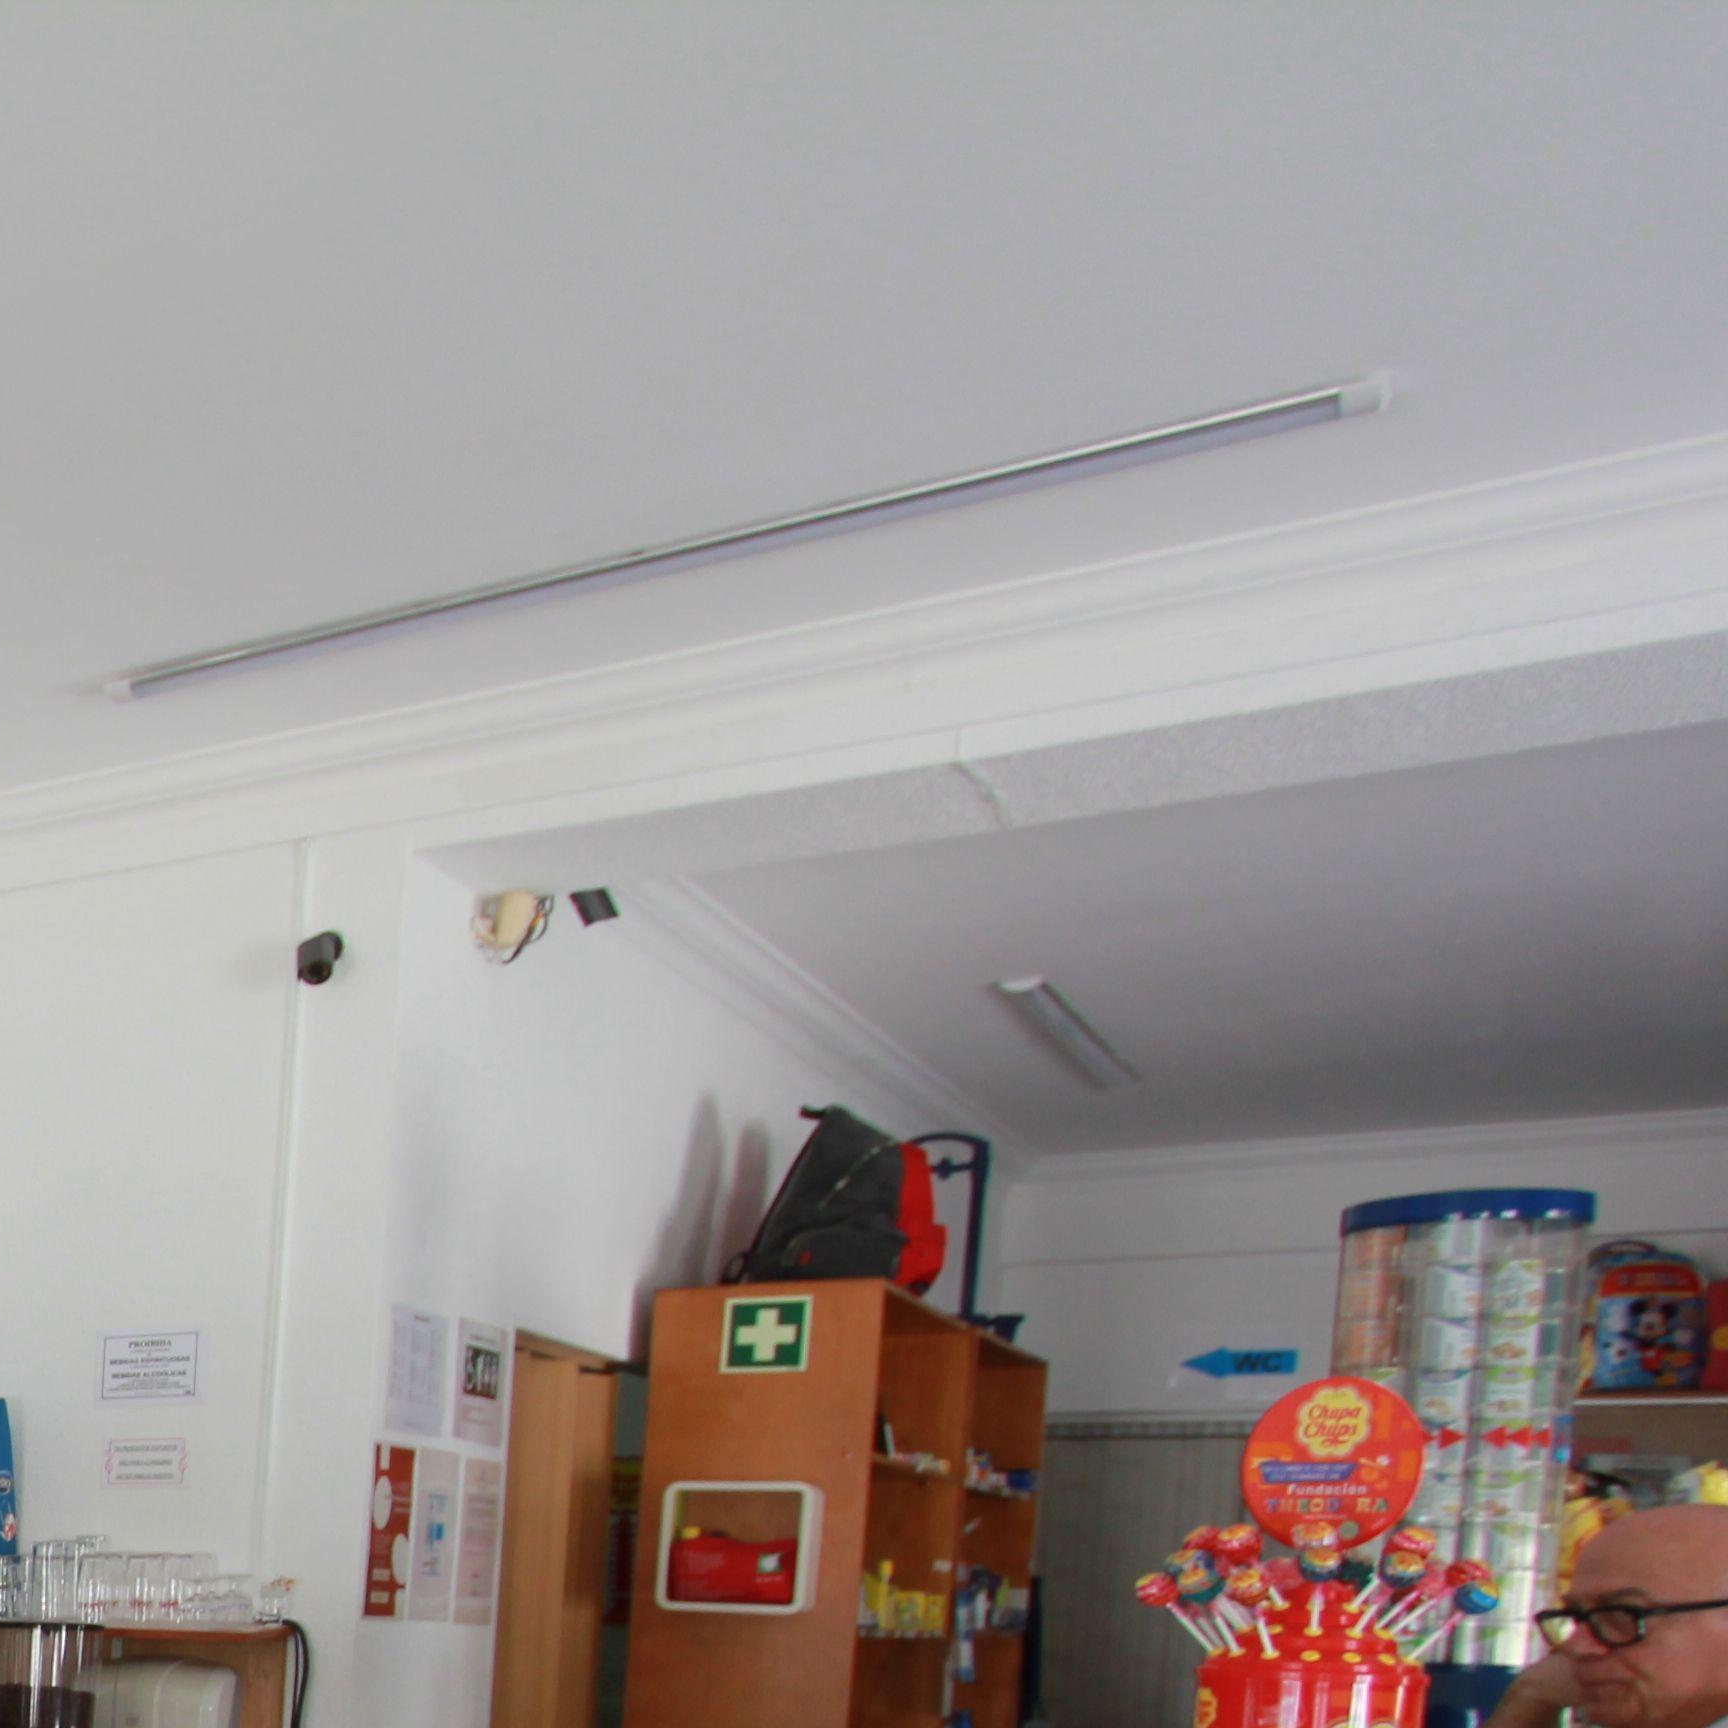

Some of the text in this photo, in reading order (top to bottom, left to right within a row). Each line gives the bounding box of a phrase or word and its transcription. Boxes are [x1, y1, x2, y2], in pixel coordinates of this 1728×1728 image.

[1232, 1350, 1283, 1374] WC
[1306, 1403, 1362, 1424] Chupa
[1302, 1419, 1358, 1447] Chups
